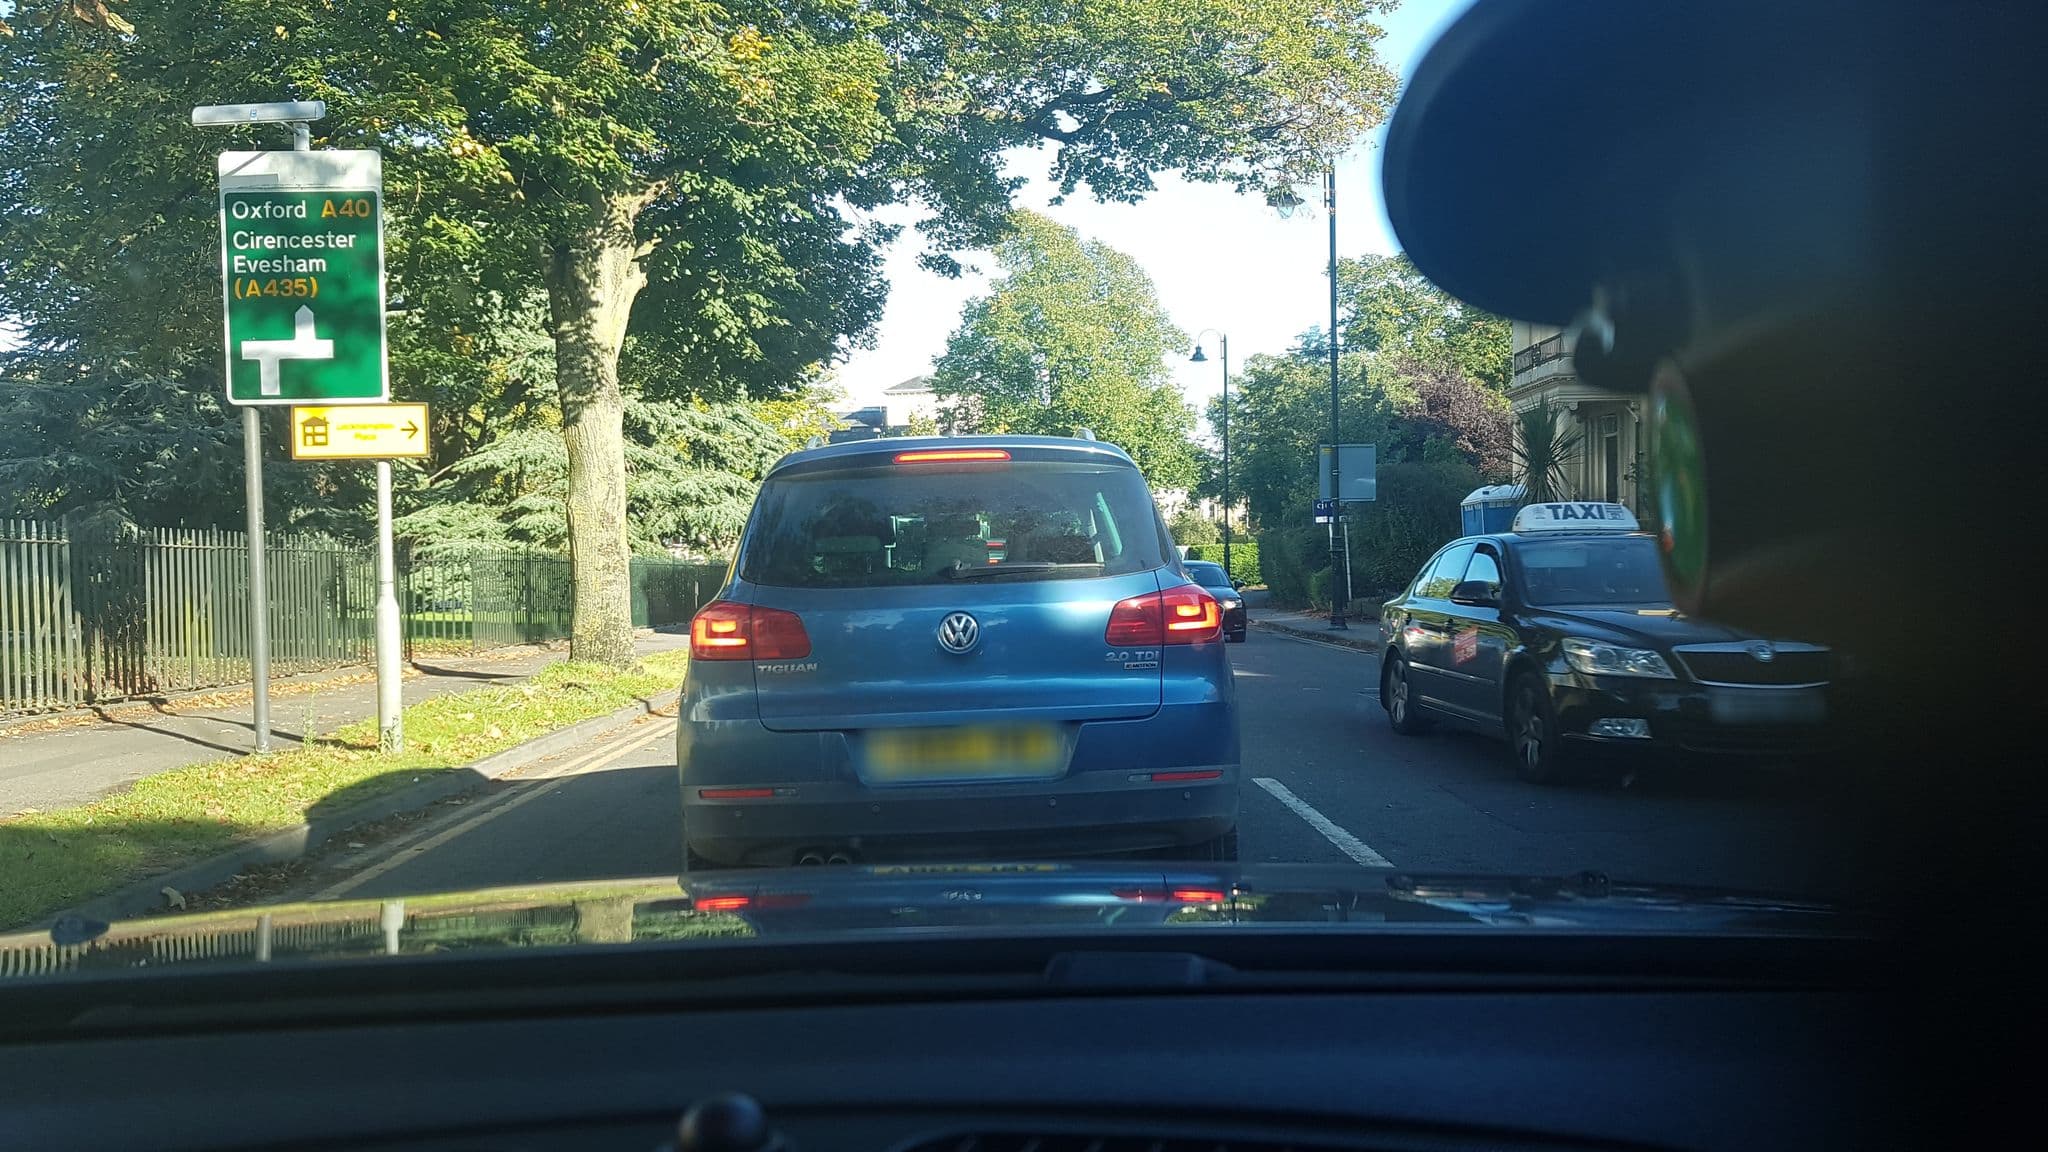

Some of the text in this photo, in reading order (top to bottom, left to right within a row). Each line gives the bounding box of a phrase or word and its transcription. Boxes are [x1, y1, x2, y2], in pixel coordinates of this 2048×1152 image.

[232, 199, 370, 219] Oxford A40
[233, 230, 356, 249] Cirencester
[233, 255, 326, 273] Evesham
[234, 277, 318, 299] (A435)
[1545, 504, 1606, 520] TAXI
[1105, 650, 1160, 662] 2.0 TDI
[757, 663, 818, 673] TIGUAN
